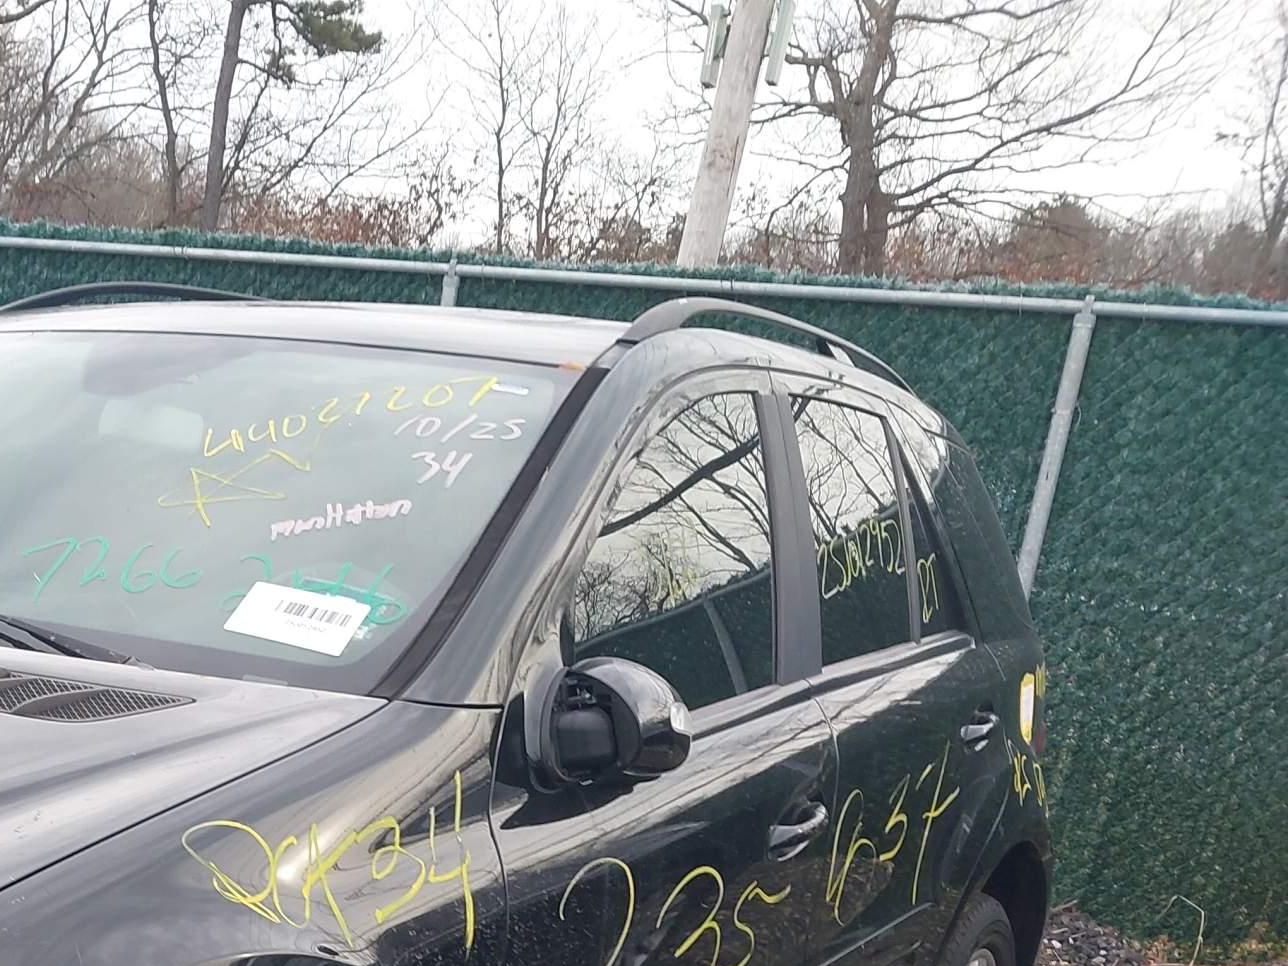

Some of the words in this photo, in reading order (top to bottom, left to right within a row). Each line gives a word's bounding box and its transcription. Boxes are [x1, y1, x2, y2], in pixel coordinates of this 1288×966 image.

[393, 412, 527, 446] 10/25
[412, 449, 474, 489] 34
[23, 533, 204, 605] 7266
